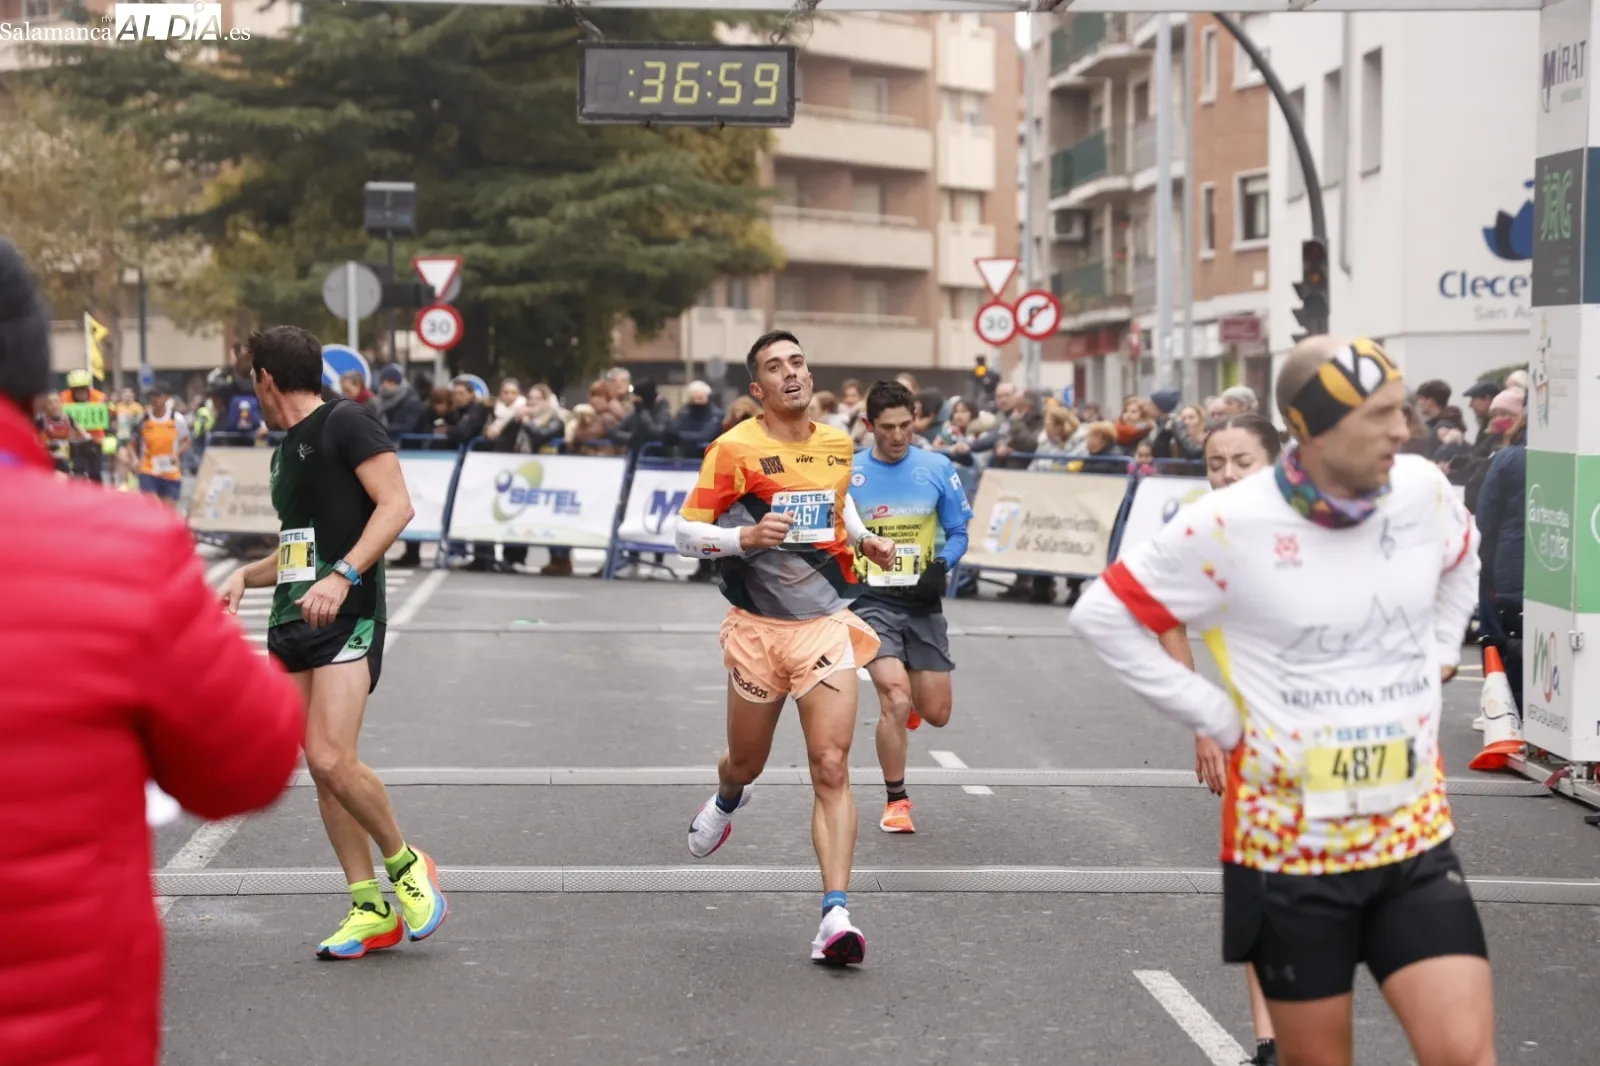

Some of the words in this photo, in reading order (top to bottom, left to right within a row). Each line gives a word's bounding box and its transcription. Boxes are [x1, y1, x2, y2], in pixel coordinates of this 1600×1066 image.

[1438, 270, 1532, 298] Clece
[427, 317, 453, 335] 30
[984, 315, 1010, 332] 30
[509, 488, 582, 507] SETEL
[791, 494, 829, 503] SETEL
[1021, 511, 1099, 532] Ayuntamiento
[1016, 536, 1029, 551] de
[738, 679, 769, 699] adidas
[1336, 723, 1406, 742] SETEL
[1331, 745, 1387, 781] 487
